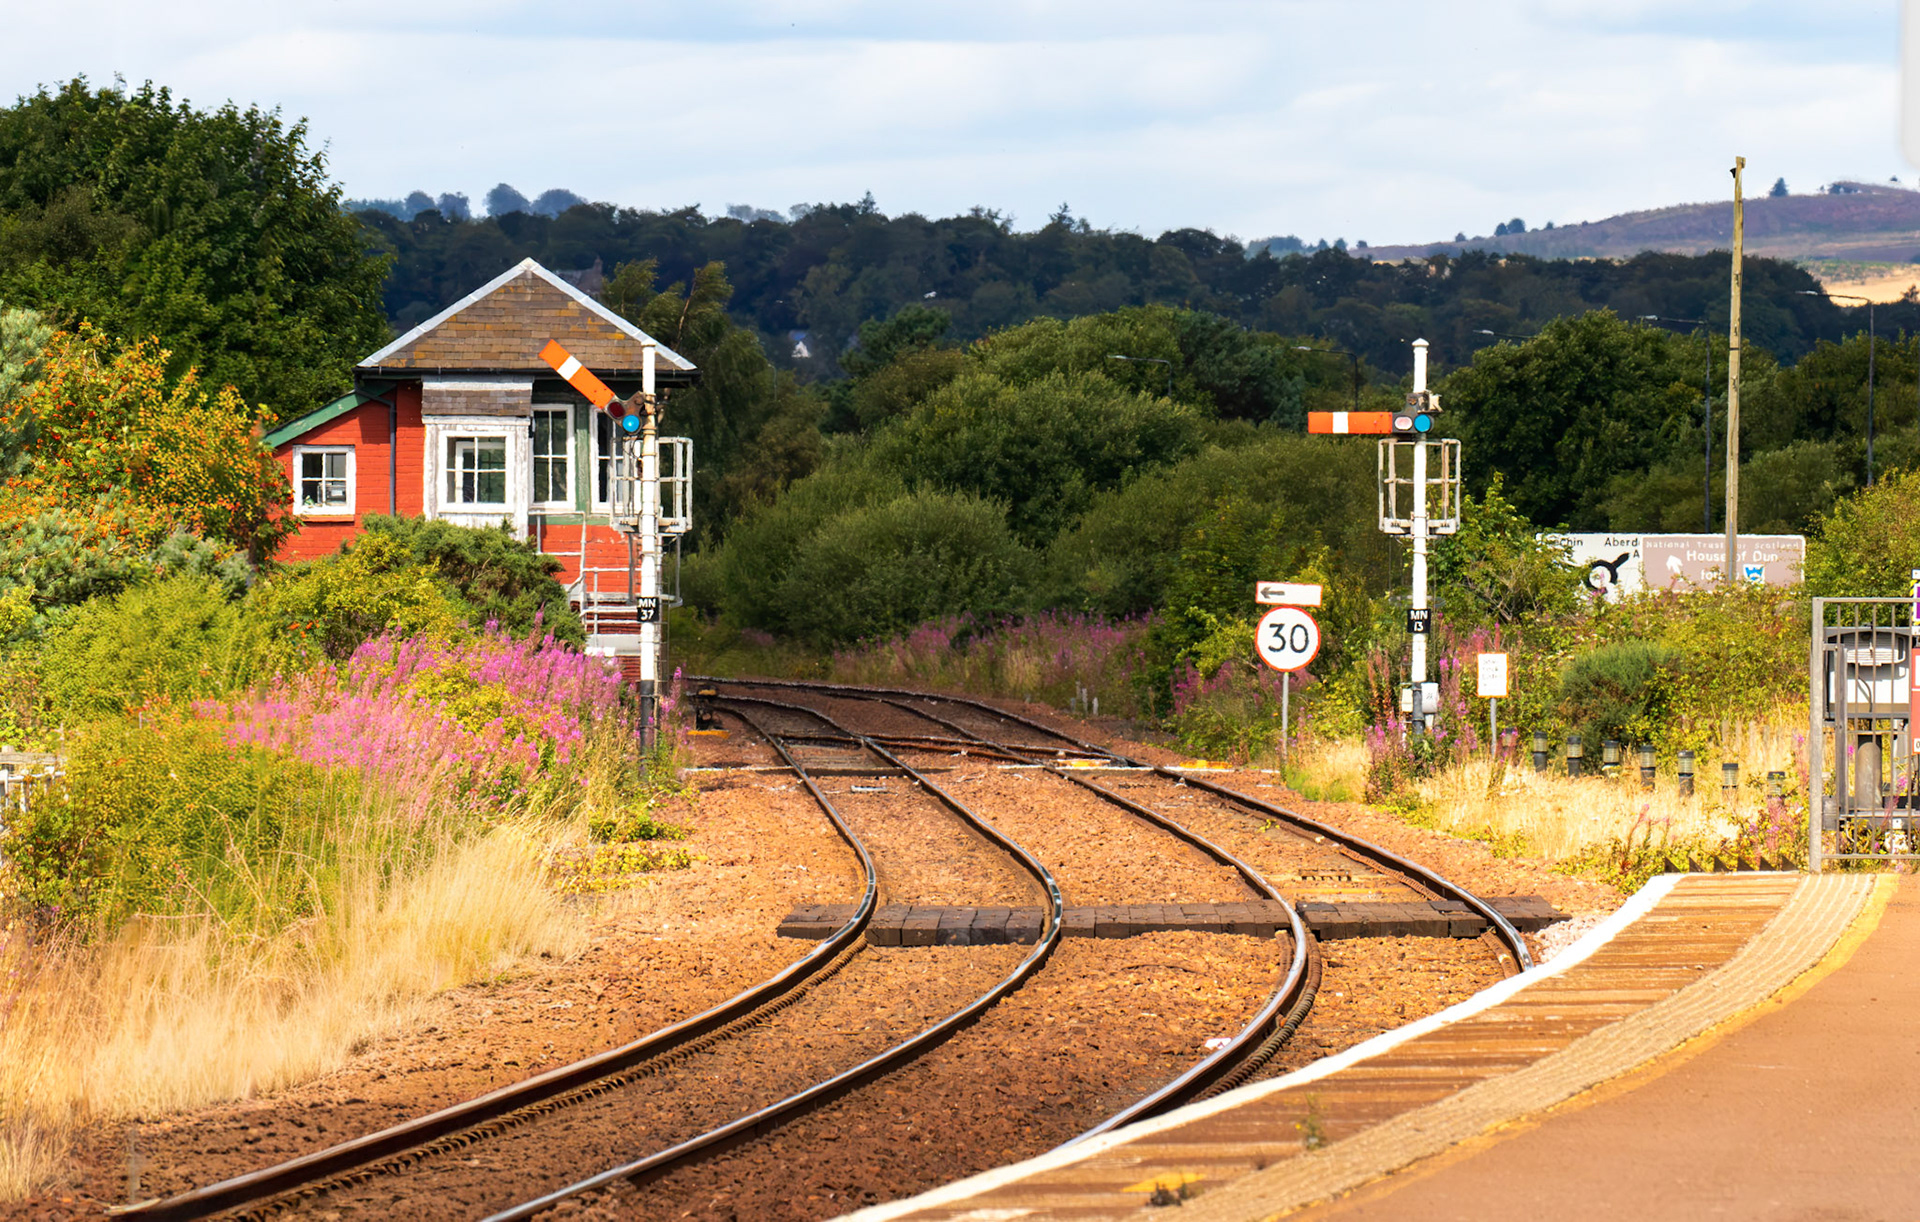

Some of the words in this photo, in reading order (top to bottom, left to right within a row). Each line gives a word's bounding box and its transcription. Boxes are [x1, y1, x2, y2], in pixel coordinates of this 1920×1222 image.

[1604, 537, 1640, 547] Aberd
[1646, 541, 1690, 549] National
[1697, 541, 1724, 549] Trust
[1754, 541, 1799, 550] Scotland
[1686, 550, 1726, 562] House
[1752, 550, 1778, 562] Dun
[639, 598, 656, 607] MN
[640, 609, 654, 621] 37
[1410, 610, 1428, 620] MN
[1267, 623, 1310, 653] 30
